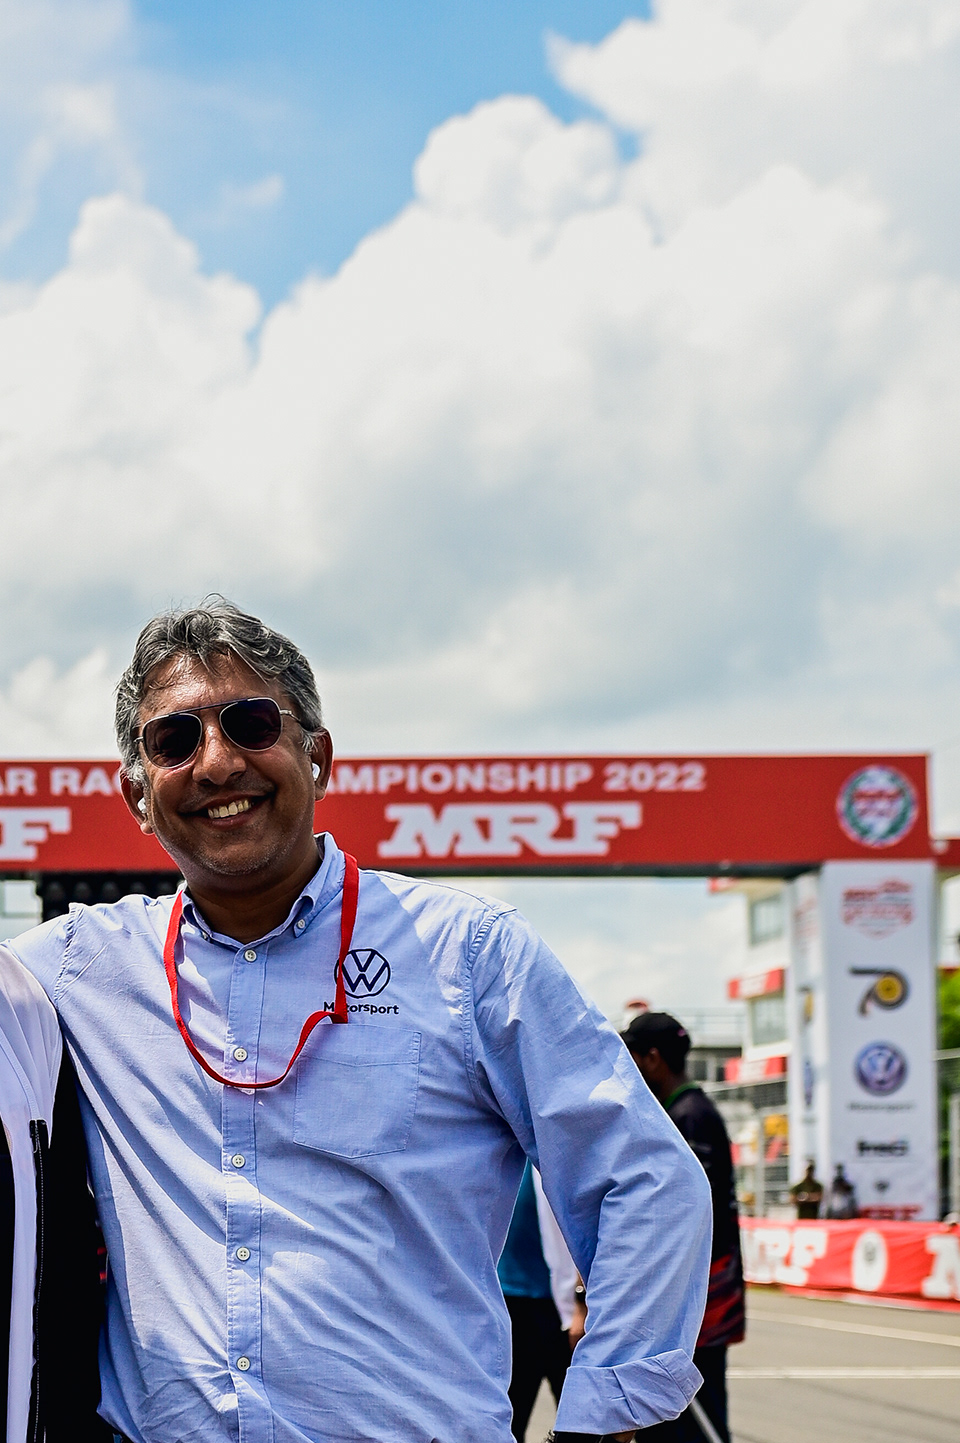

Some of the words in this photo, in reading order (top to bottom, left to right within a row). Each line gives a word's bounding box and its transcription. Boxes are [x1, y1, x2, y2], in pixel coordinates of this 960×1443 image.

[605, 763, 706, 793] 2022
[377, 802, 642, 858] MRF
[323, 1001, 400, 1015] Morsport
